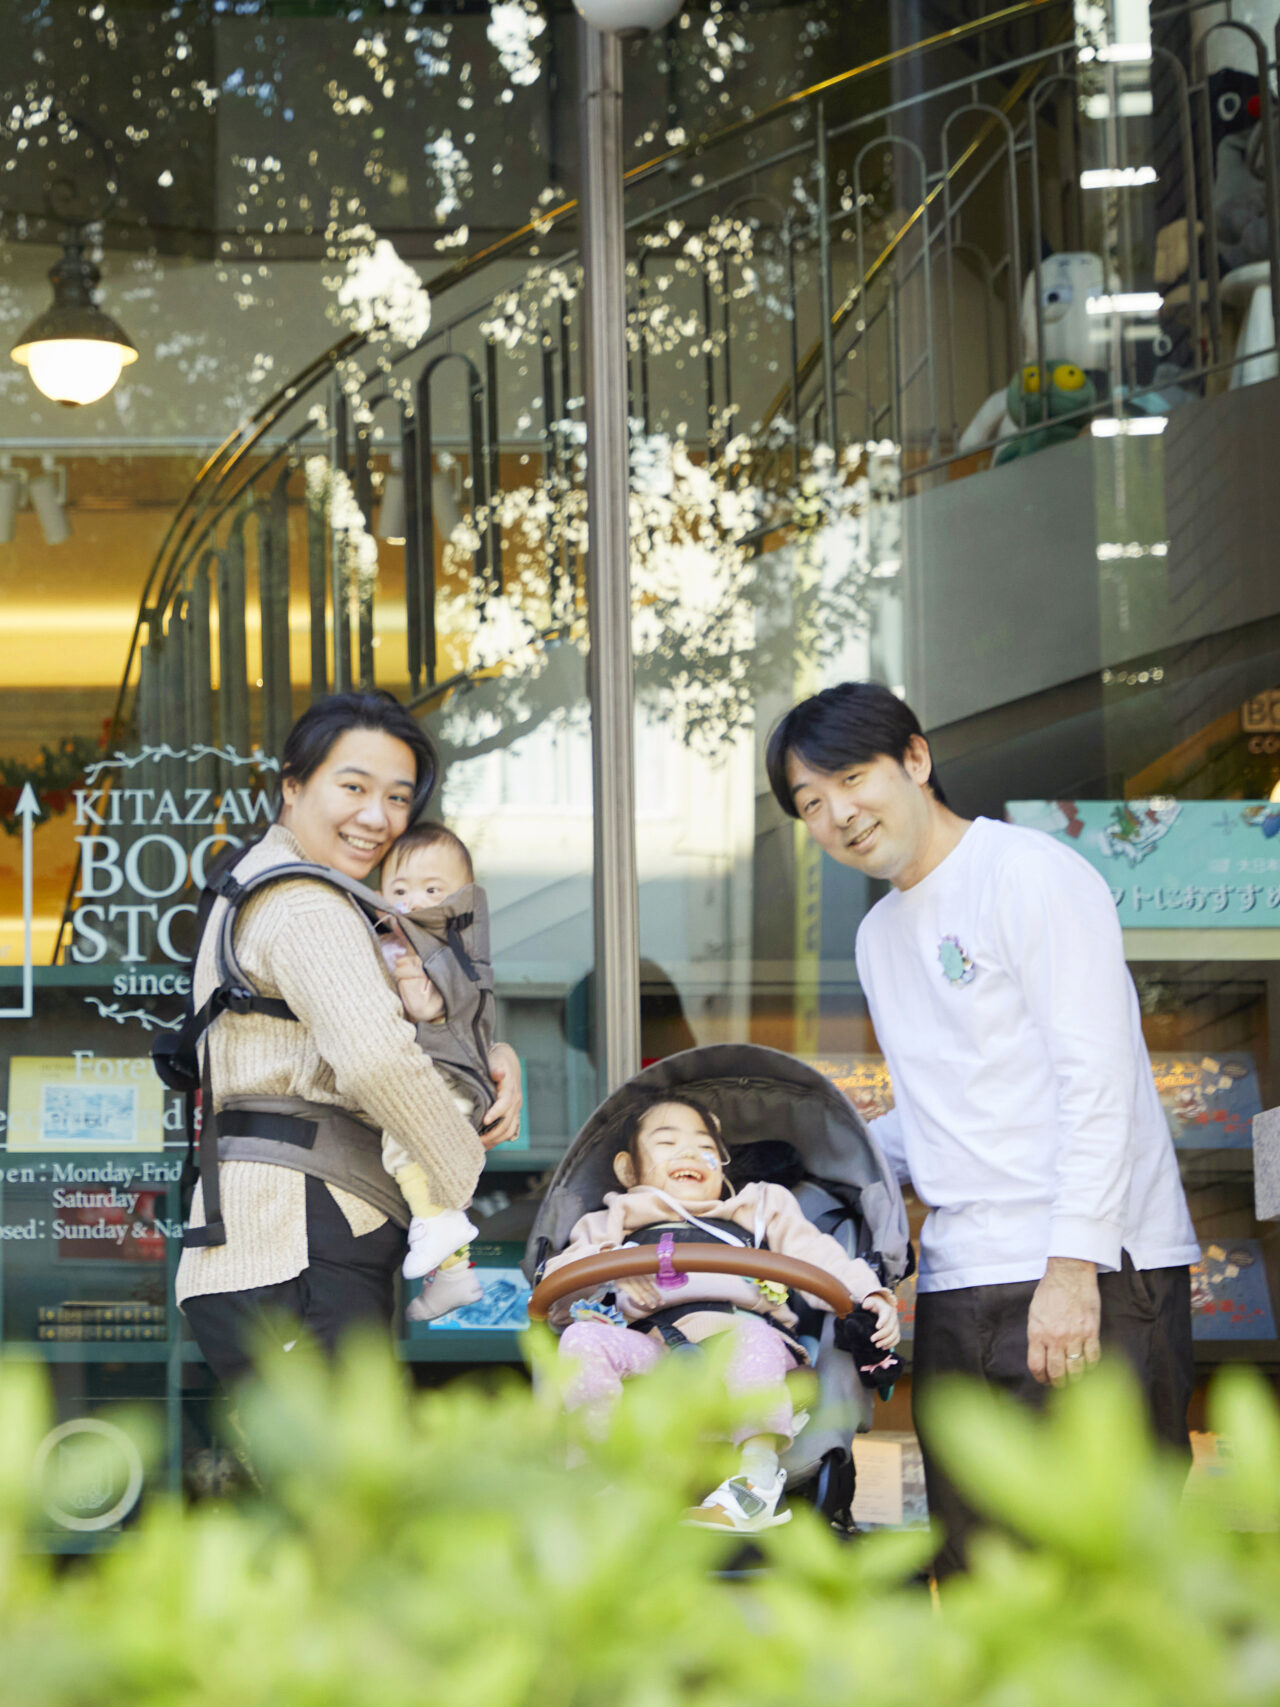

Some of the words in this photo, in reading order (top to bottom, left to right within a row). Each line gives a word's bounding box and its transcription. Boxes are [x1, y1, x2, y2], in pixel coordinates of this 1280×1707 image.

[53, 1187, 140, 1214] Saturday
[52, 1218, 129, 1245] Sunday
[131, 1221, 147, 1239] &
